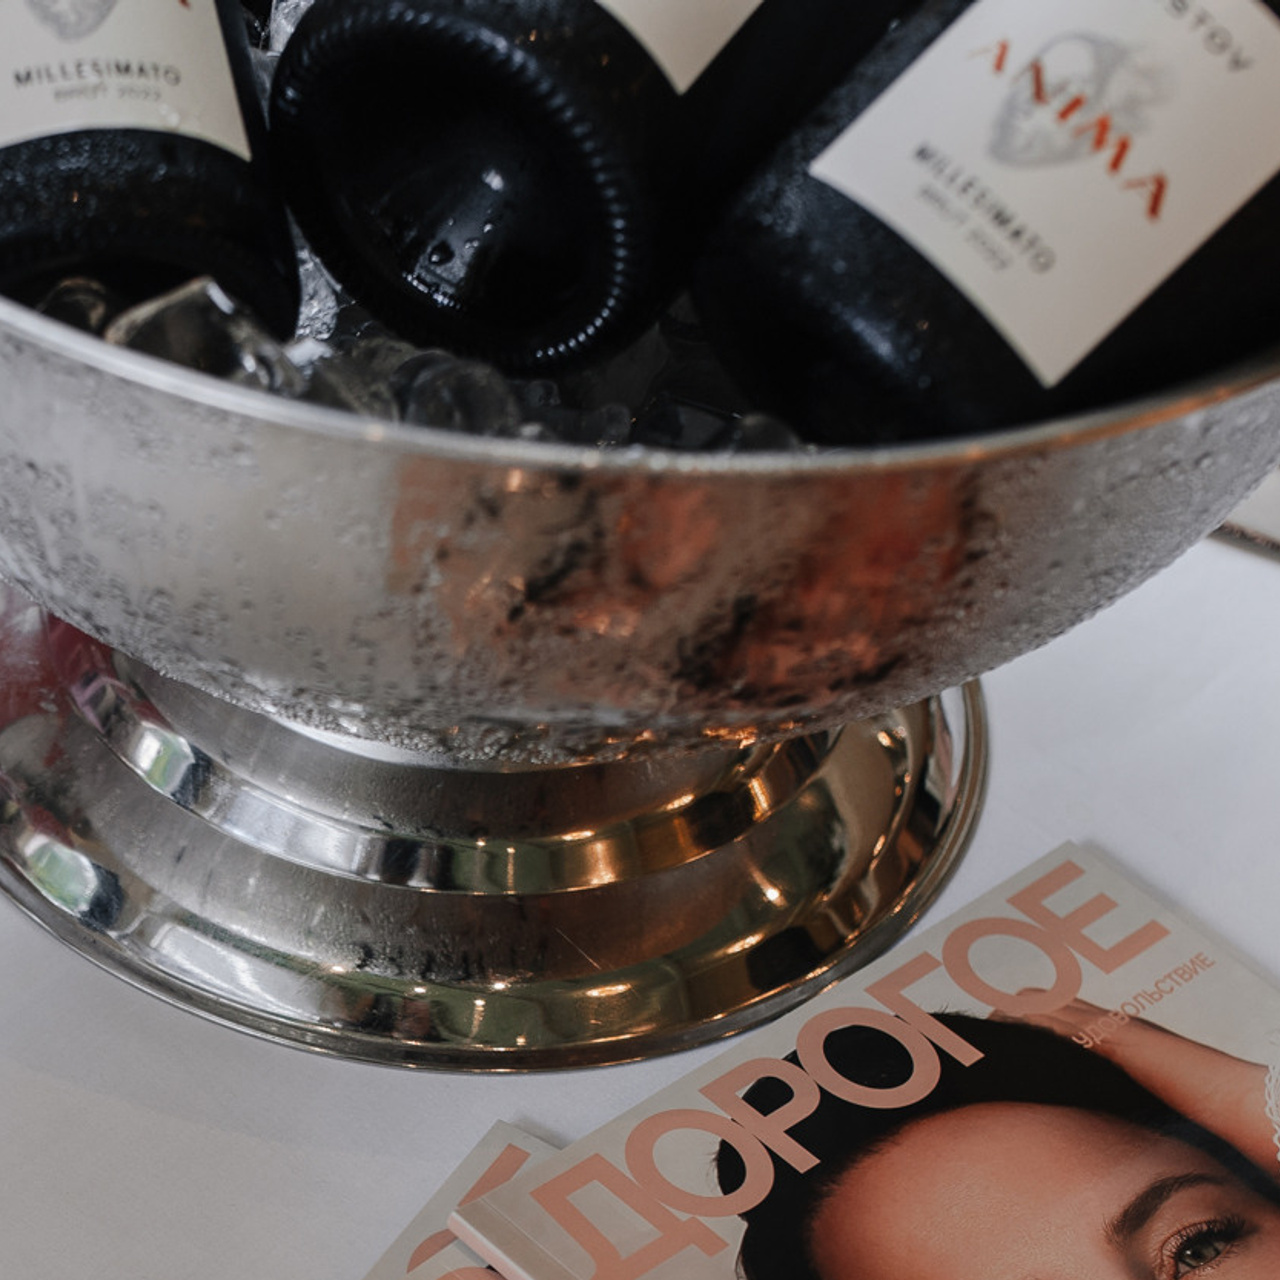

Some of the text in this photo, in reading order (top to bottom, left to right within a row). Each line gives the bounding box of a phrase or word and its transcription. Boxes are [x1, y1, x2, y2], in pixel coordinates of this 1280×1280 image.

[14, 60, 182, 89] MILLESIMATO
[967, 38, 1169, 223] ANIMA
[914, 142, 1057, 275] MILLESIMATO
[1072, 952, 1217, 1050] УДОВОЛЬСТВИЕ
